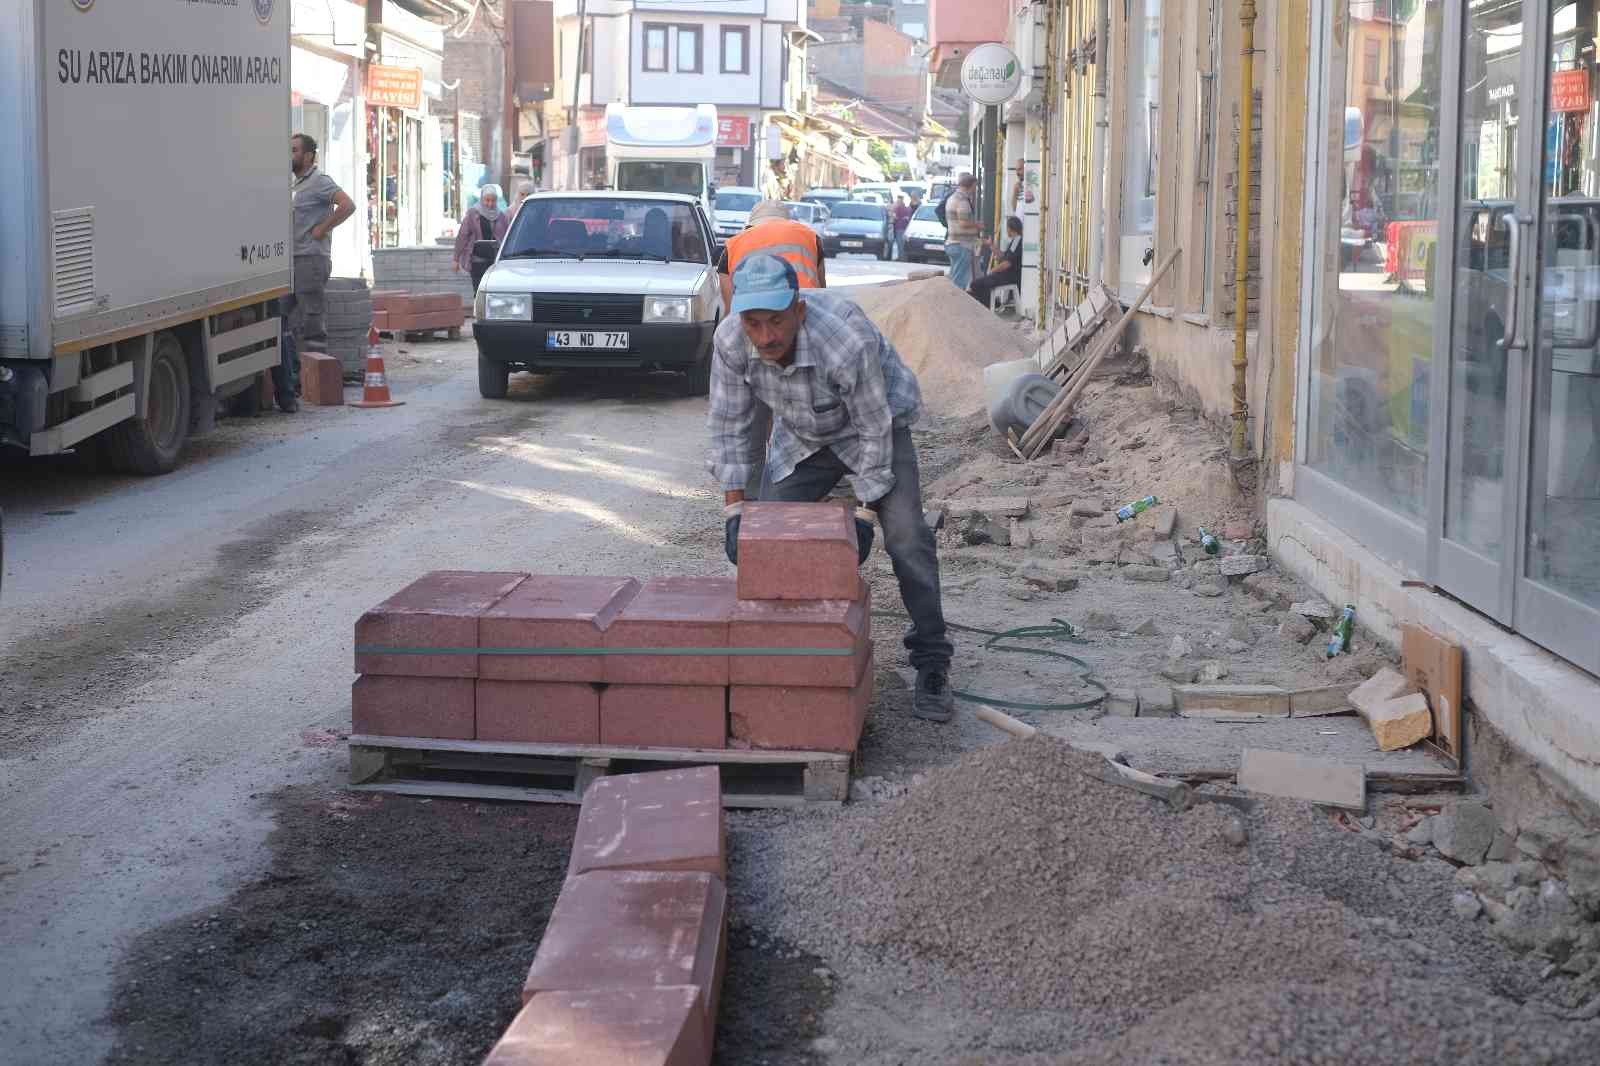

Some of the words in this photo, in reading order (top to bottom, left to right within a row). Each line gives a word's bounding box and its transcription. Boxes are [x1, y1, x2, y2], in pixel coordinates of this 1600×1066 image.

[58, 48, 81, 84] SU
[86, 50, 136, 84] ARIZA
[140, 52, 188, 84] BAKIM
[191, 54, 243, 85] ONARIM
[245, 56, 281, 84] ARACI
[557, 333, 570, 346] 43
[580, 333, 595, 347] ND
[605, 333, 626, 347] 774
